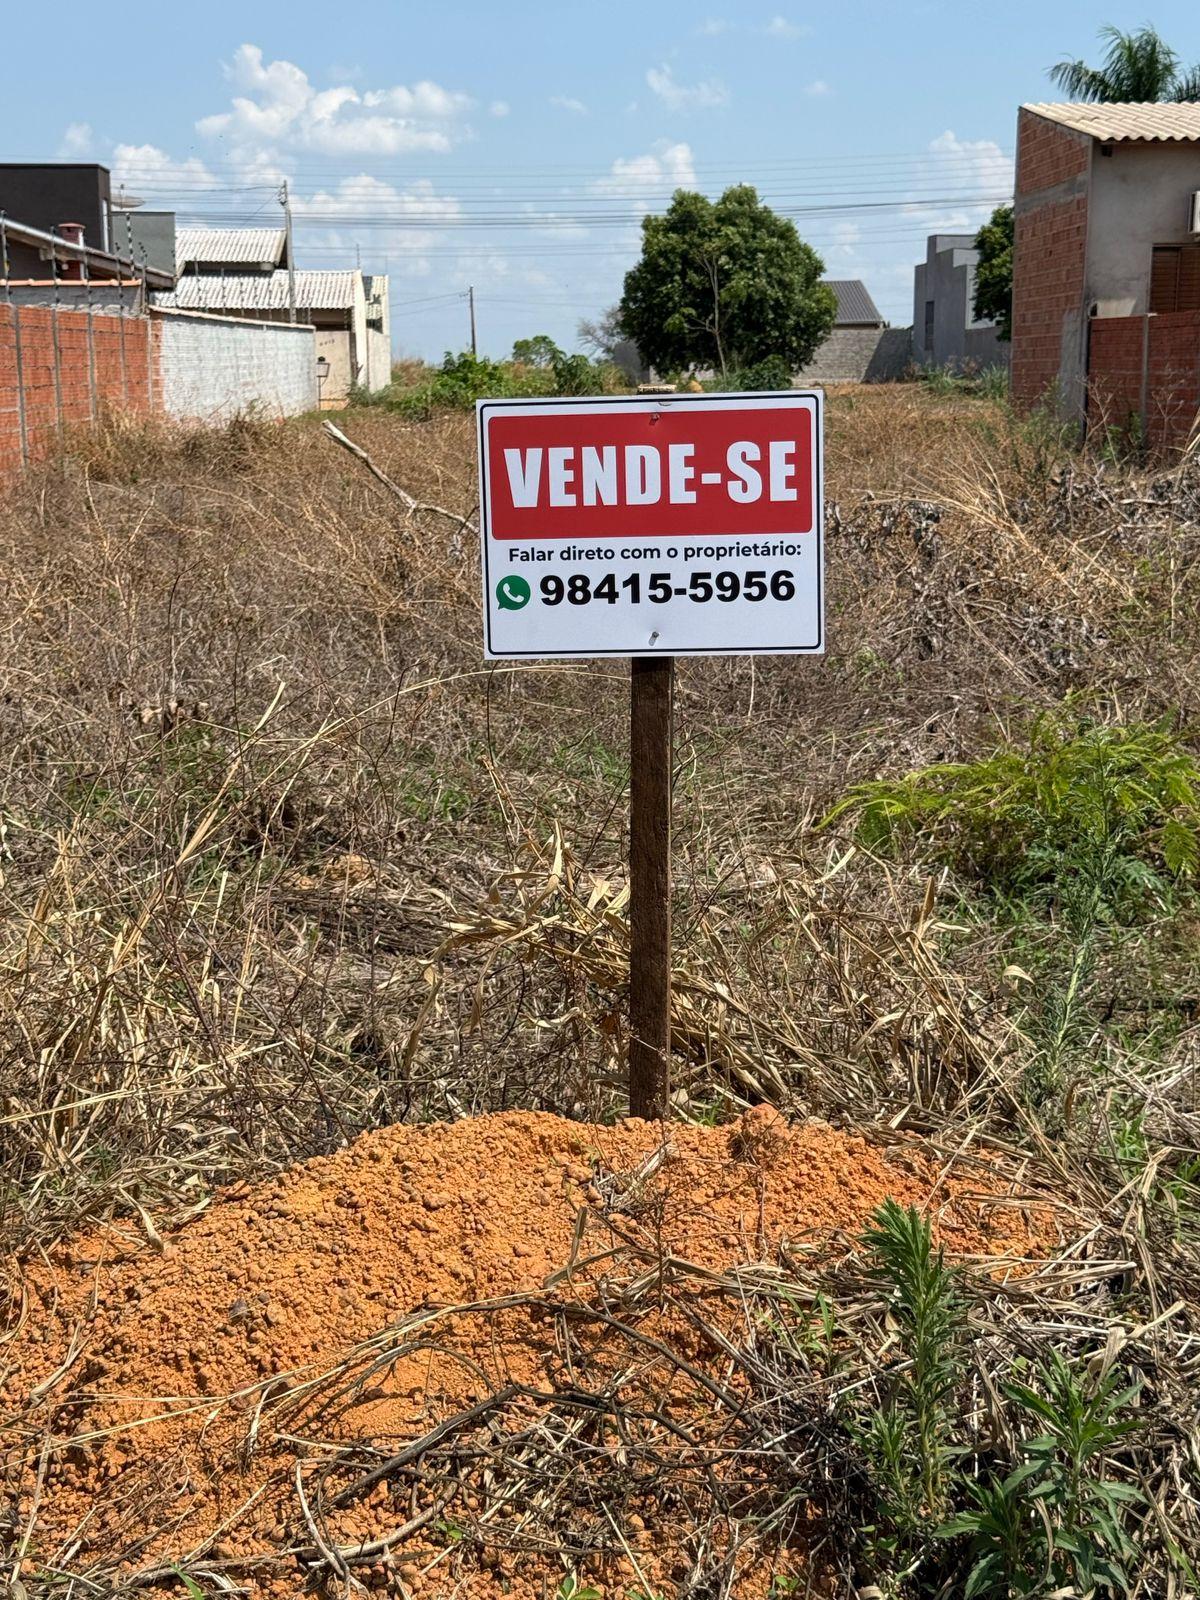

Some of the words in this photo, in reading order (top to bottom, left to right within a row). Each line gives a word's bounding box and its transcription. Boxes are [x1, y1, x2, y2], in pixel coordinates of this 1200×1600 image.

[503, 441, 798, 508] VENDE-SE
[509, 547, 554, 562] Falar
[560, 545, 615, 561] direto
[620, 546, 661, 560] com
[666, 547, 678, 559] o
[684, 540, 802, 561] proprietário:
[539, 570, 795, 606] 98415-5956
